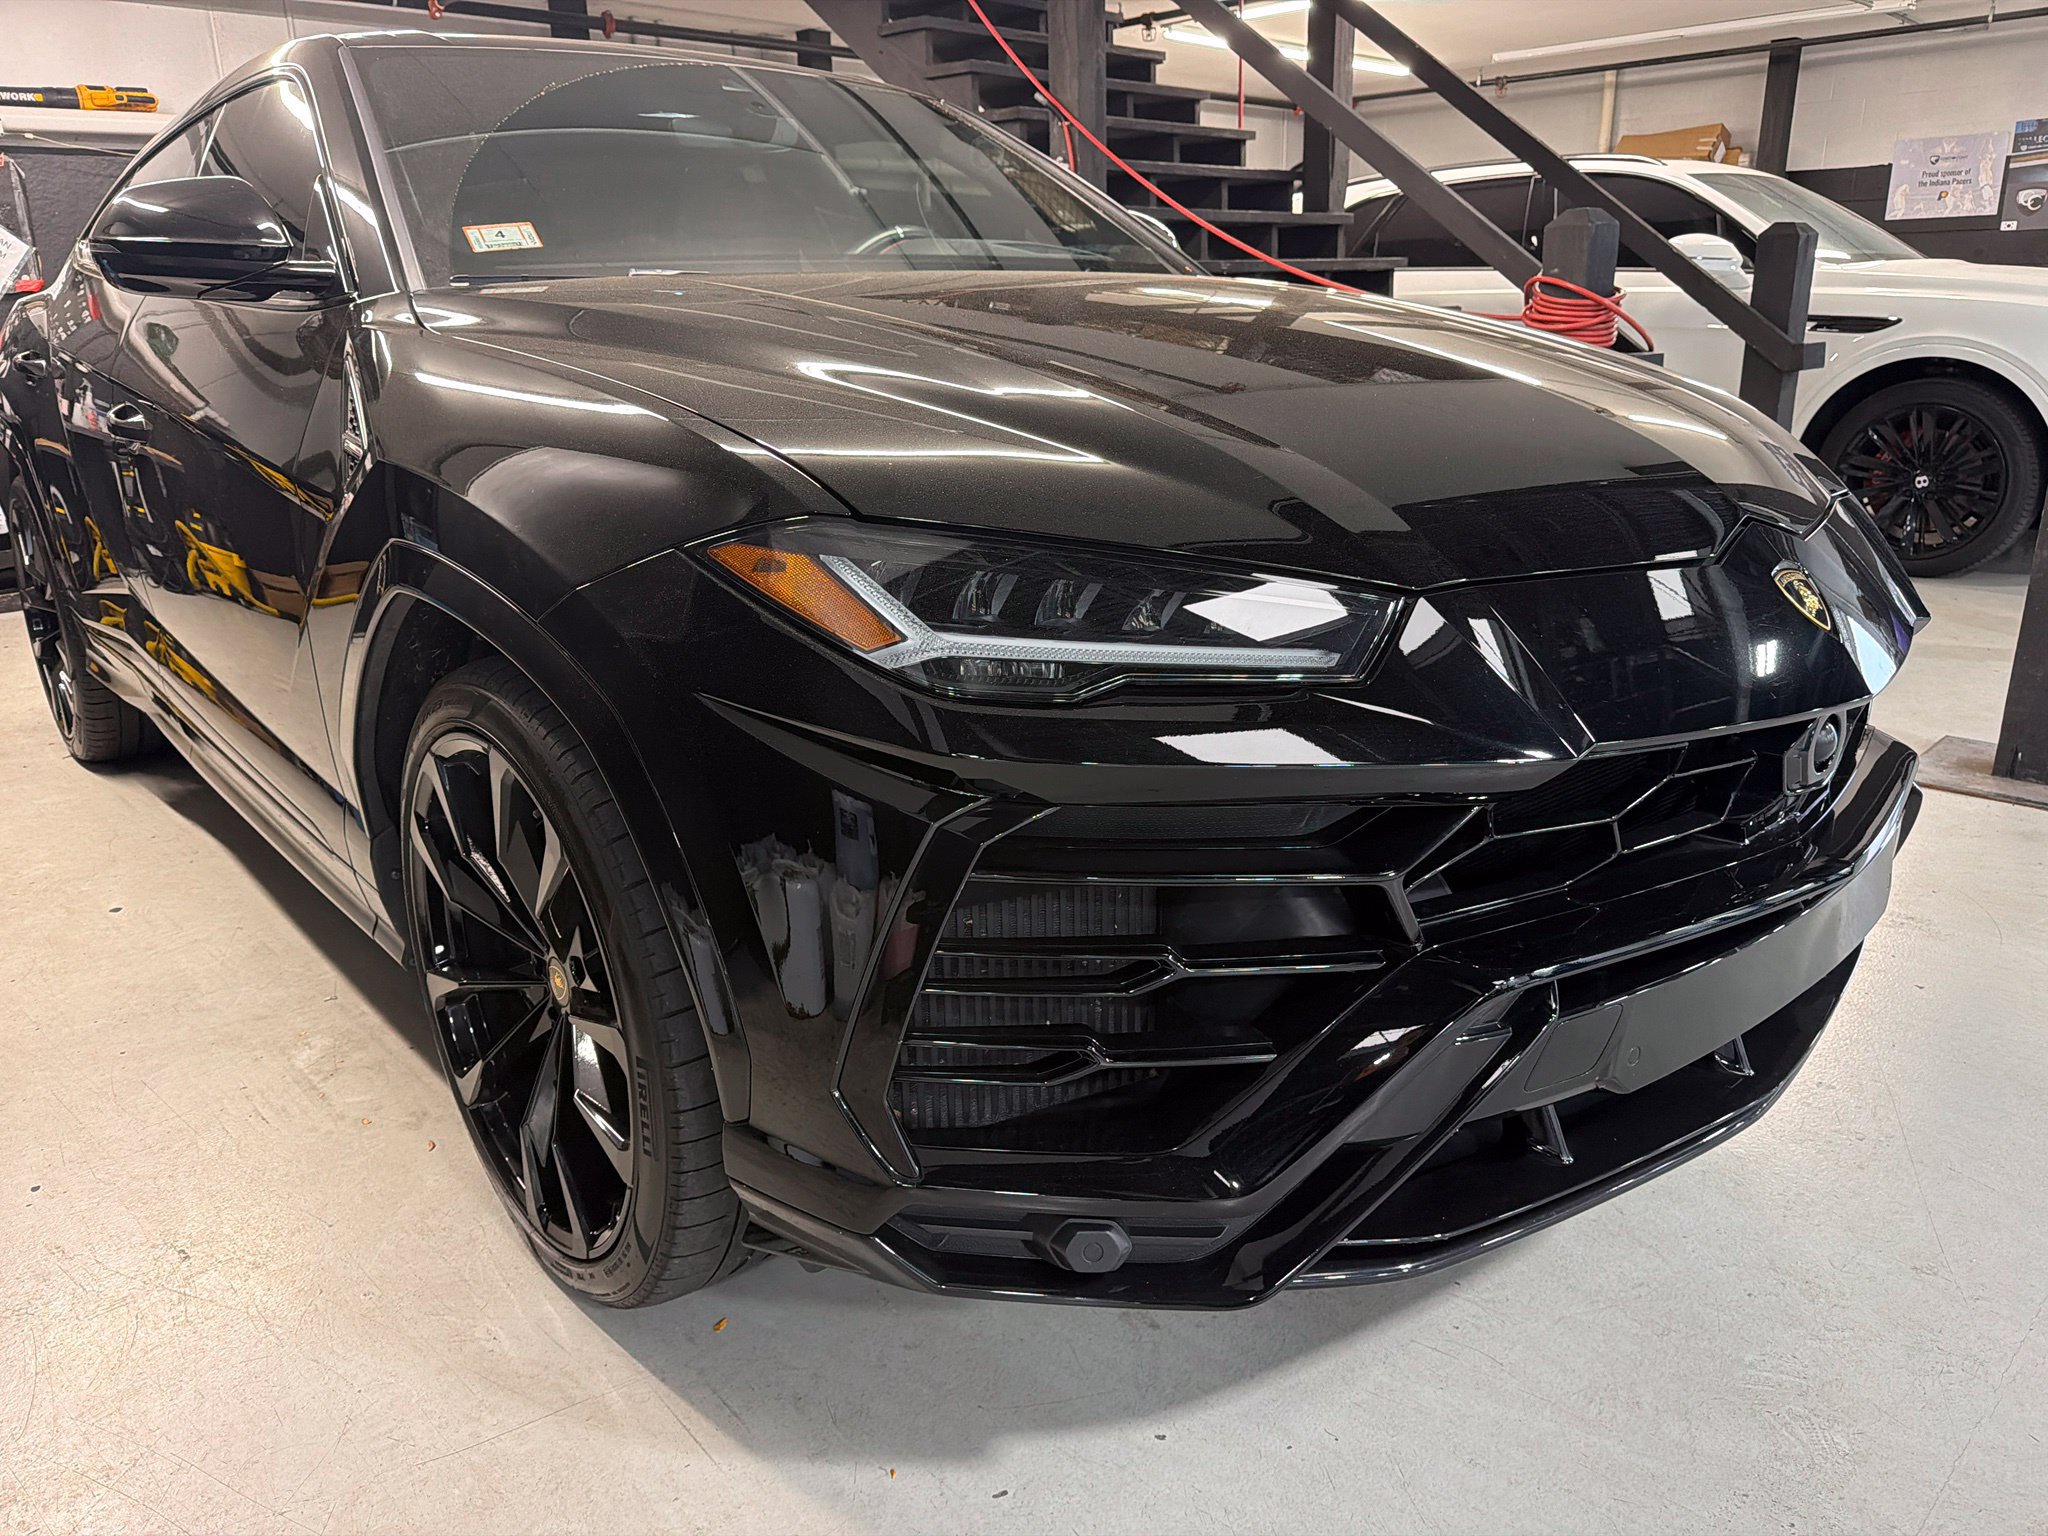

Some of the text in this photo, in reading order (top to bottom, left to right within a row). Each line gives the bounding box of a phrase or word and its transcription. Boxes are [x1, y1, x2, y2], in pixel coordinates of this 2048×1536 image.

[1921, 170, 1939, 178] Proud
[1940, 169, 1963, 177] sponsor
[494, 230, 505, 238] 4
[636, 1056, 655, 1159] PIRELLI
